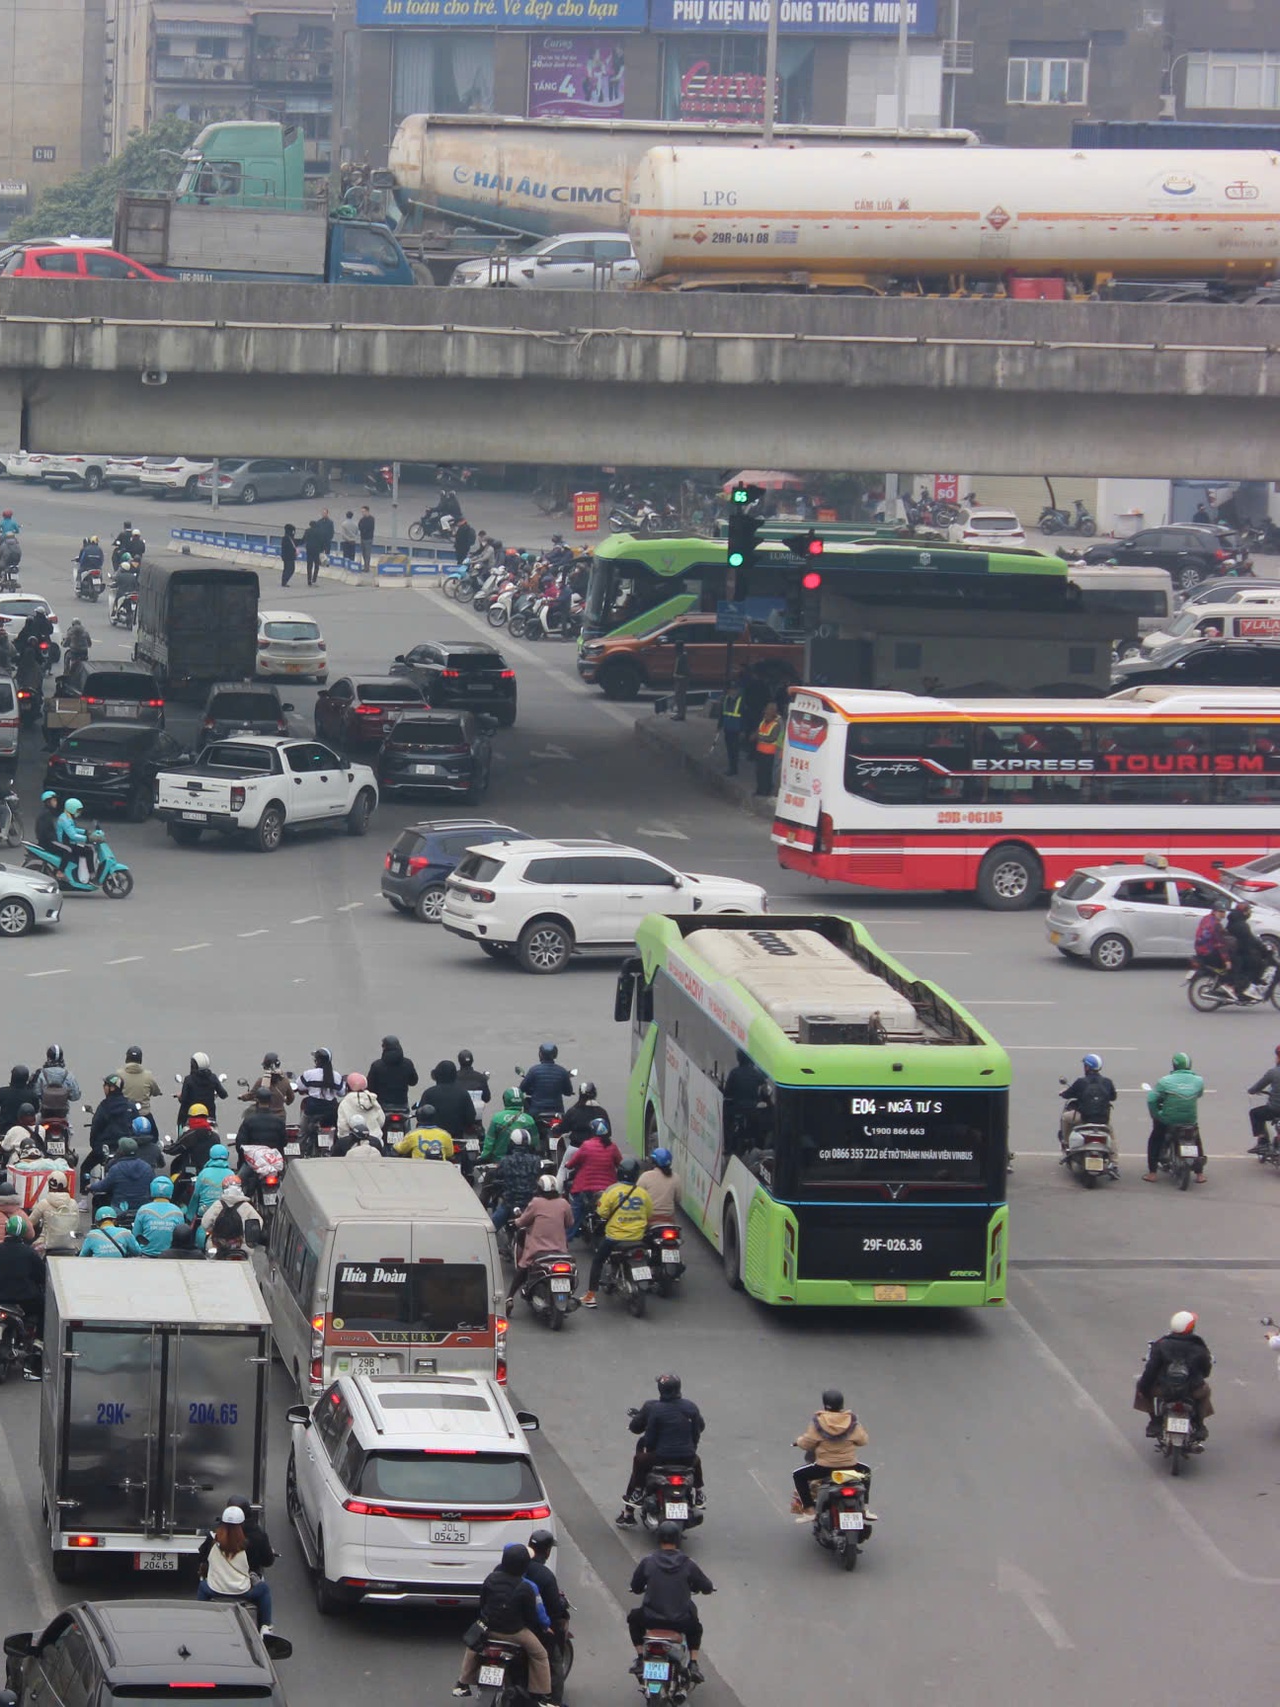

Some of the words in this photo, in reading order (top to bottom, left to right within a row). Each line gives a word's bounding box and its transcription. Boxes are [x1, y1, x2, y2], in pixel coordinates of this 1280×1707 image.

[444, 0, 470, 14] cho
[557, 0, 585, 16] cho
[587, 0, 618, 20] bạn
[559, 74, 576, 98] 4
[551, 186, 623, 203] CIMC
[703, 191, 737, 206] LPG
[937, 484, 955, 499] SỐ
[856, 762, 919, 777] Signature
[972, 758, 1094, 771] EXPRESS
[1104, 754, 1264, 771] TOURISM
[852, 1098, 877, 1114] E04
[888, 1099, 913, 1113] NGÃ
[917, 1100, 930, 1113] TƯ
[934, 1101, 942, 1113] S
[872, 1127, 891, 1135] 1900
[893, 1127, 908, 1135] 866
[910, 1127, 925, 1135] 663
[832, 1149, 849, 1160] 0866
[850, 1149, 864, 1160] 355
[865, 1149, 879, 1160] 222
[952, 1151, 973, 1161] VINBUS
[617, 1191, 643, 1210] be
[863, 1238, 923, 1251] 29F-026.36
[340, 1267, 367, 1283] Hứa
[372, 1268, 407, 1283] Đoàn
[382, 1333, 438, 1341] LUXURY
[358, 1358, 375, 1367] 29B
[189, 1403, 238, 1424] 204.65
[441, 1523, 458, 1532] 30L
[434, 1533, 466, 1542] 054.25
[150, 1552, 167, 1561] 29K
[143, 1561, 174, 1569] 204.65
